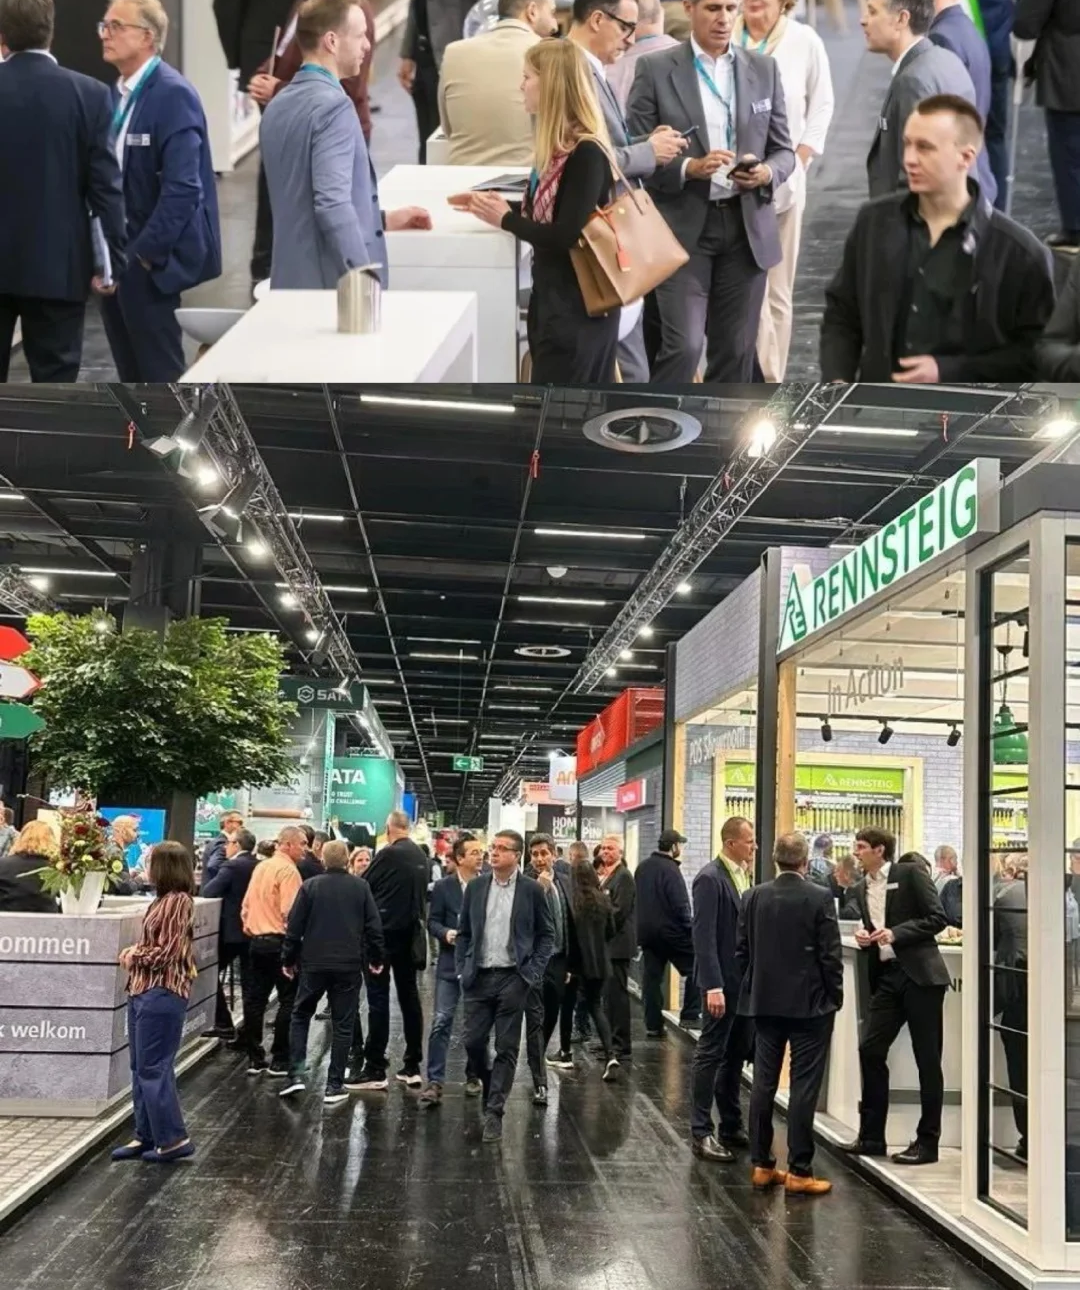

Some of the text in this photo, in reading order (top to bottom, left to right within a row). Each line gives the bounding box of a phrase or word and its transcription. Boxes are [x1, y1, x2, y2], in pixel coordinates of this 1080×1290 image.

[813, 466, 976, 630] RENNSTEIG
[828, 654, 904, 715] In Action
[330, 768, 368, 785] ATA
[11, 1020, 86, 1039] welkom
